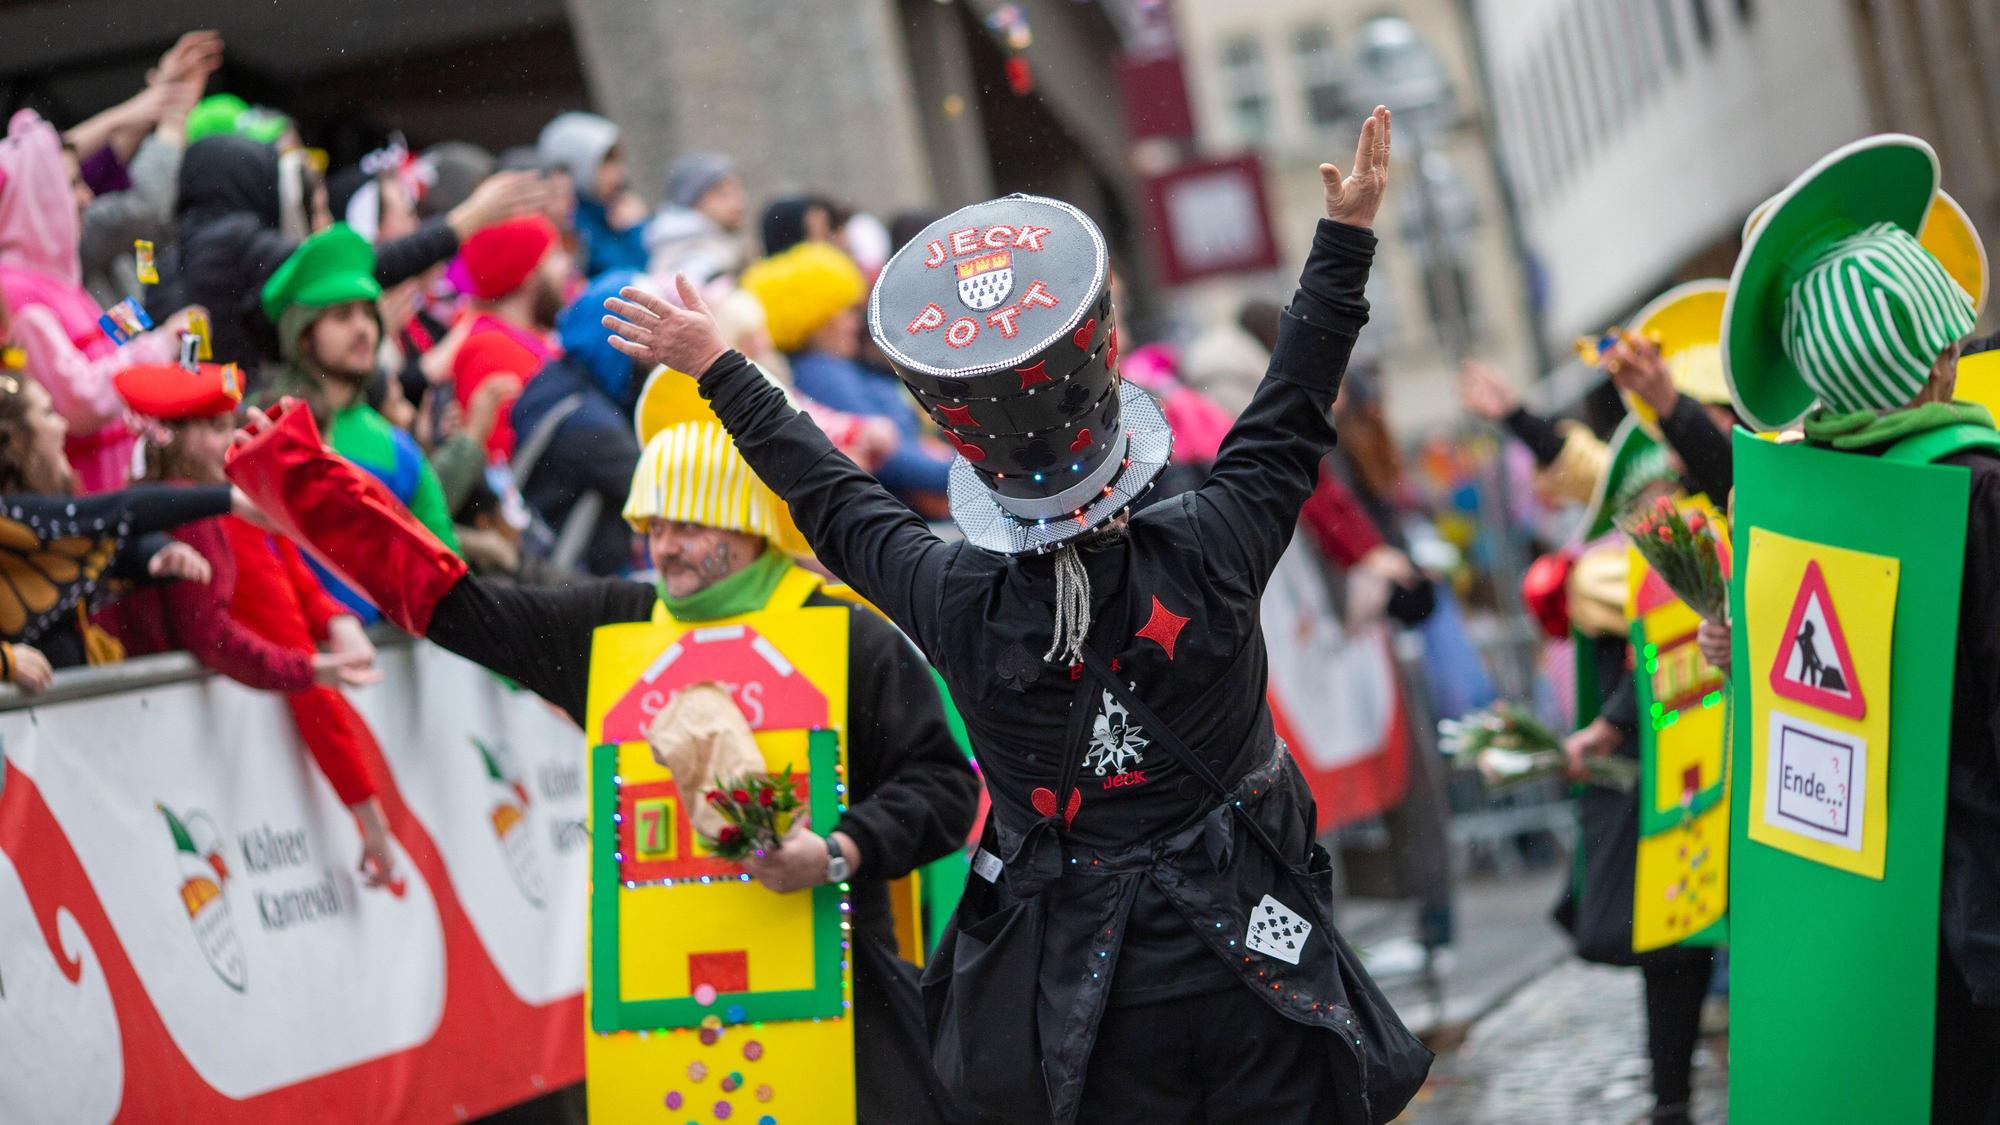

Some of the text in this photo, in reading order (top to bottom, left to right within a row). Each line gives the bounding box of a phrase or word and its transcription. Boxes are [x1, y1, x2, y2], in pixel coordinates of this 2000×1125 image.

[924, 224, 1052, 269] JECK
[905, 279, 1059, 349] POTT
[238, 822, 309, 875] Kölner
[641, 810, 661, 847] 7
[253, 866, 342, 931] Karneval
